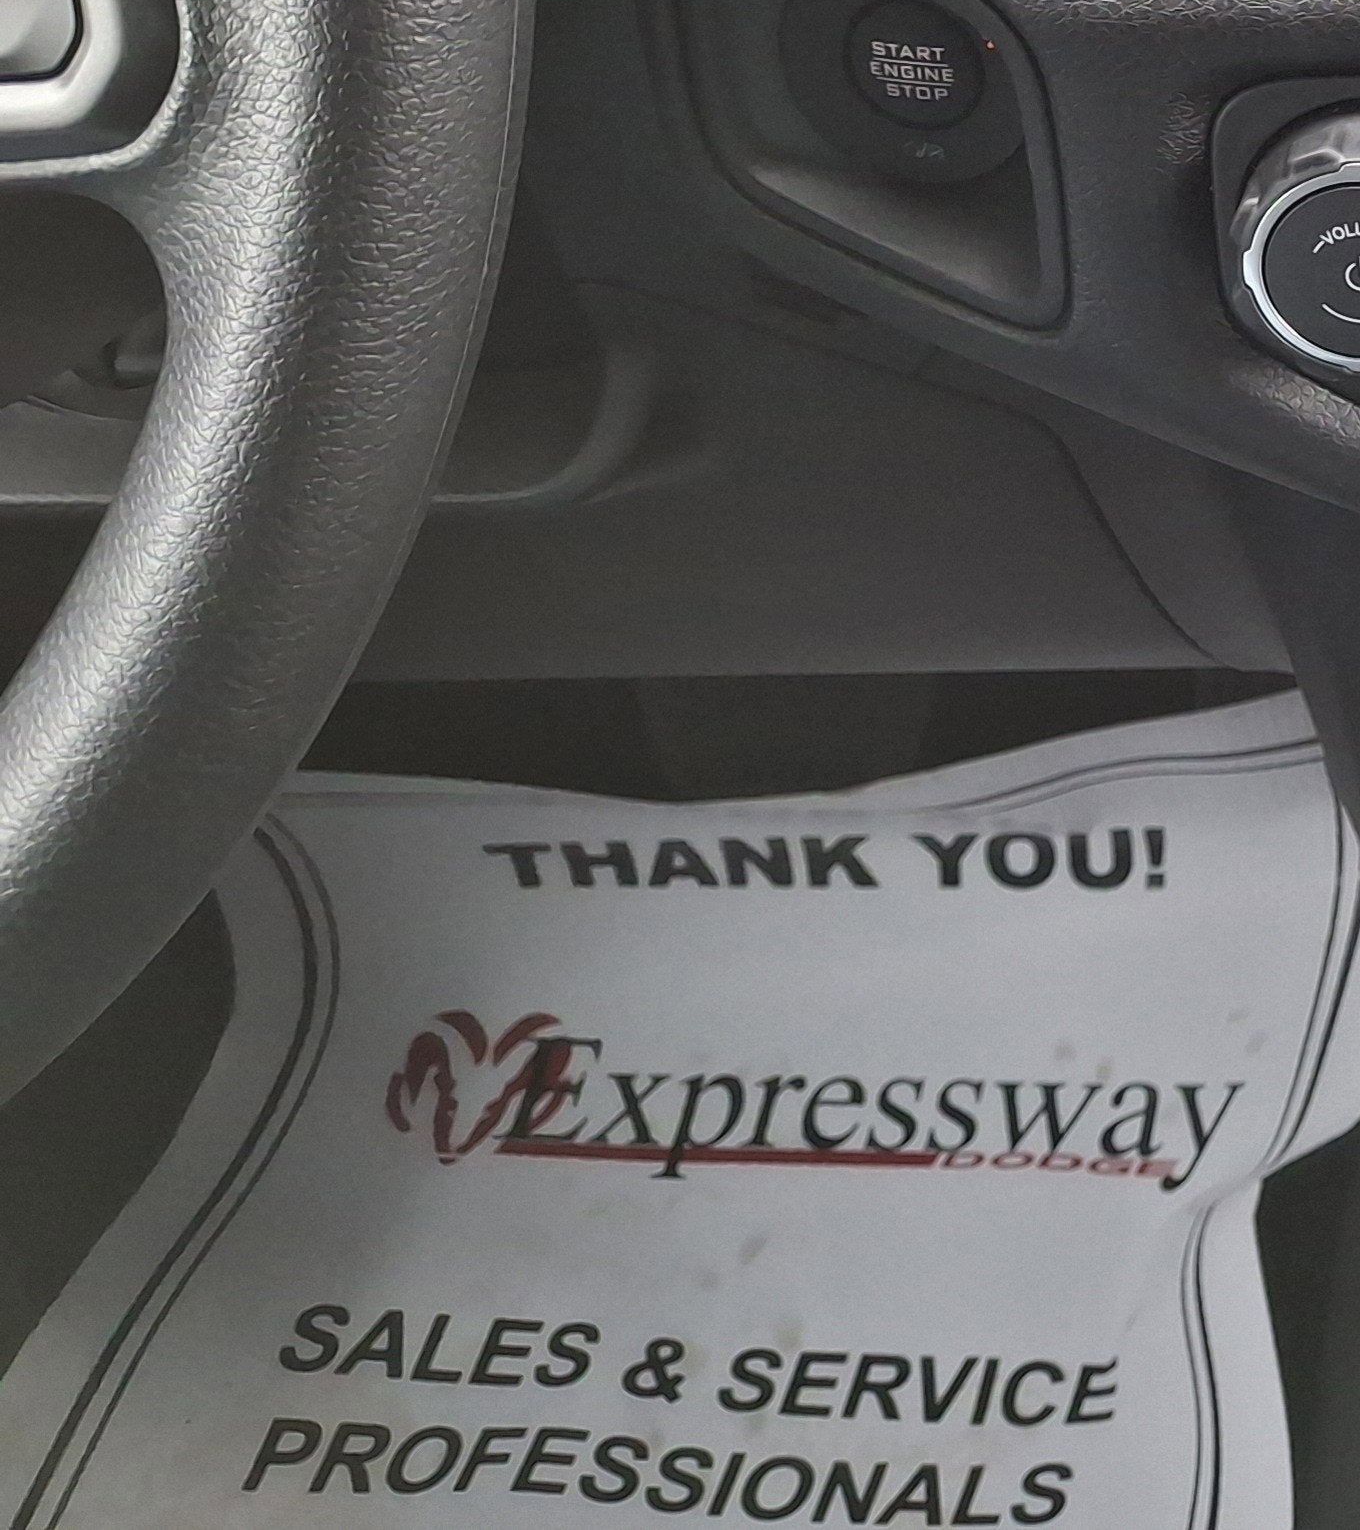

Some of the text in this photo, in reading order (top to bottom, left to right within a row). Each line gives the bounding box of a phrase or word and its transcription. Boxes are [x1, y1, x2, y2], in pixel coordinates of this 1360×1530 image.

[869, 61, 954, 82] ENGINE
[871, 41, 946, 62] START
[886, 83, 949, 101] STOP
[483, 826, 1167, 890] THANK YOU!
[495, 1037, 1245, 1190] Expressway
[279, 1304, 1117, 1428] SALES & SERVICE
[241, 1418, 1073, 1528] PROFESSIONALS
